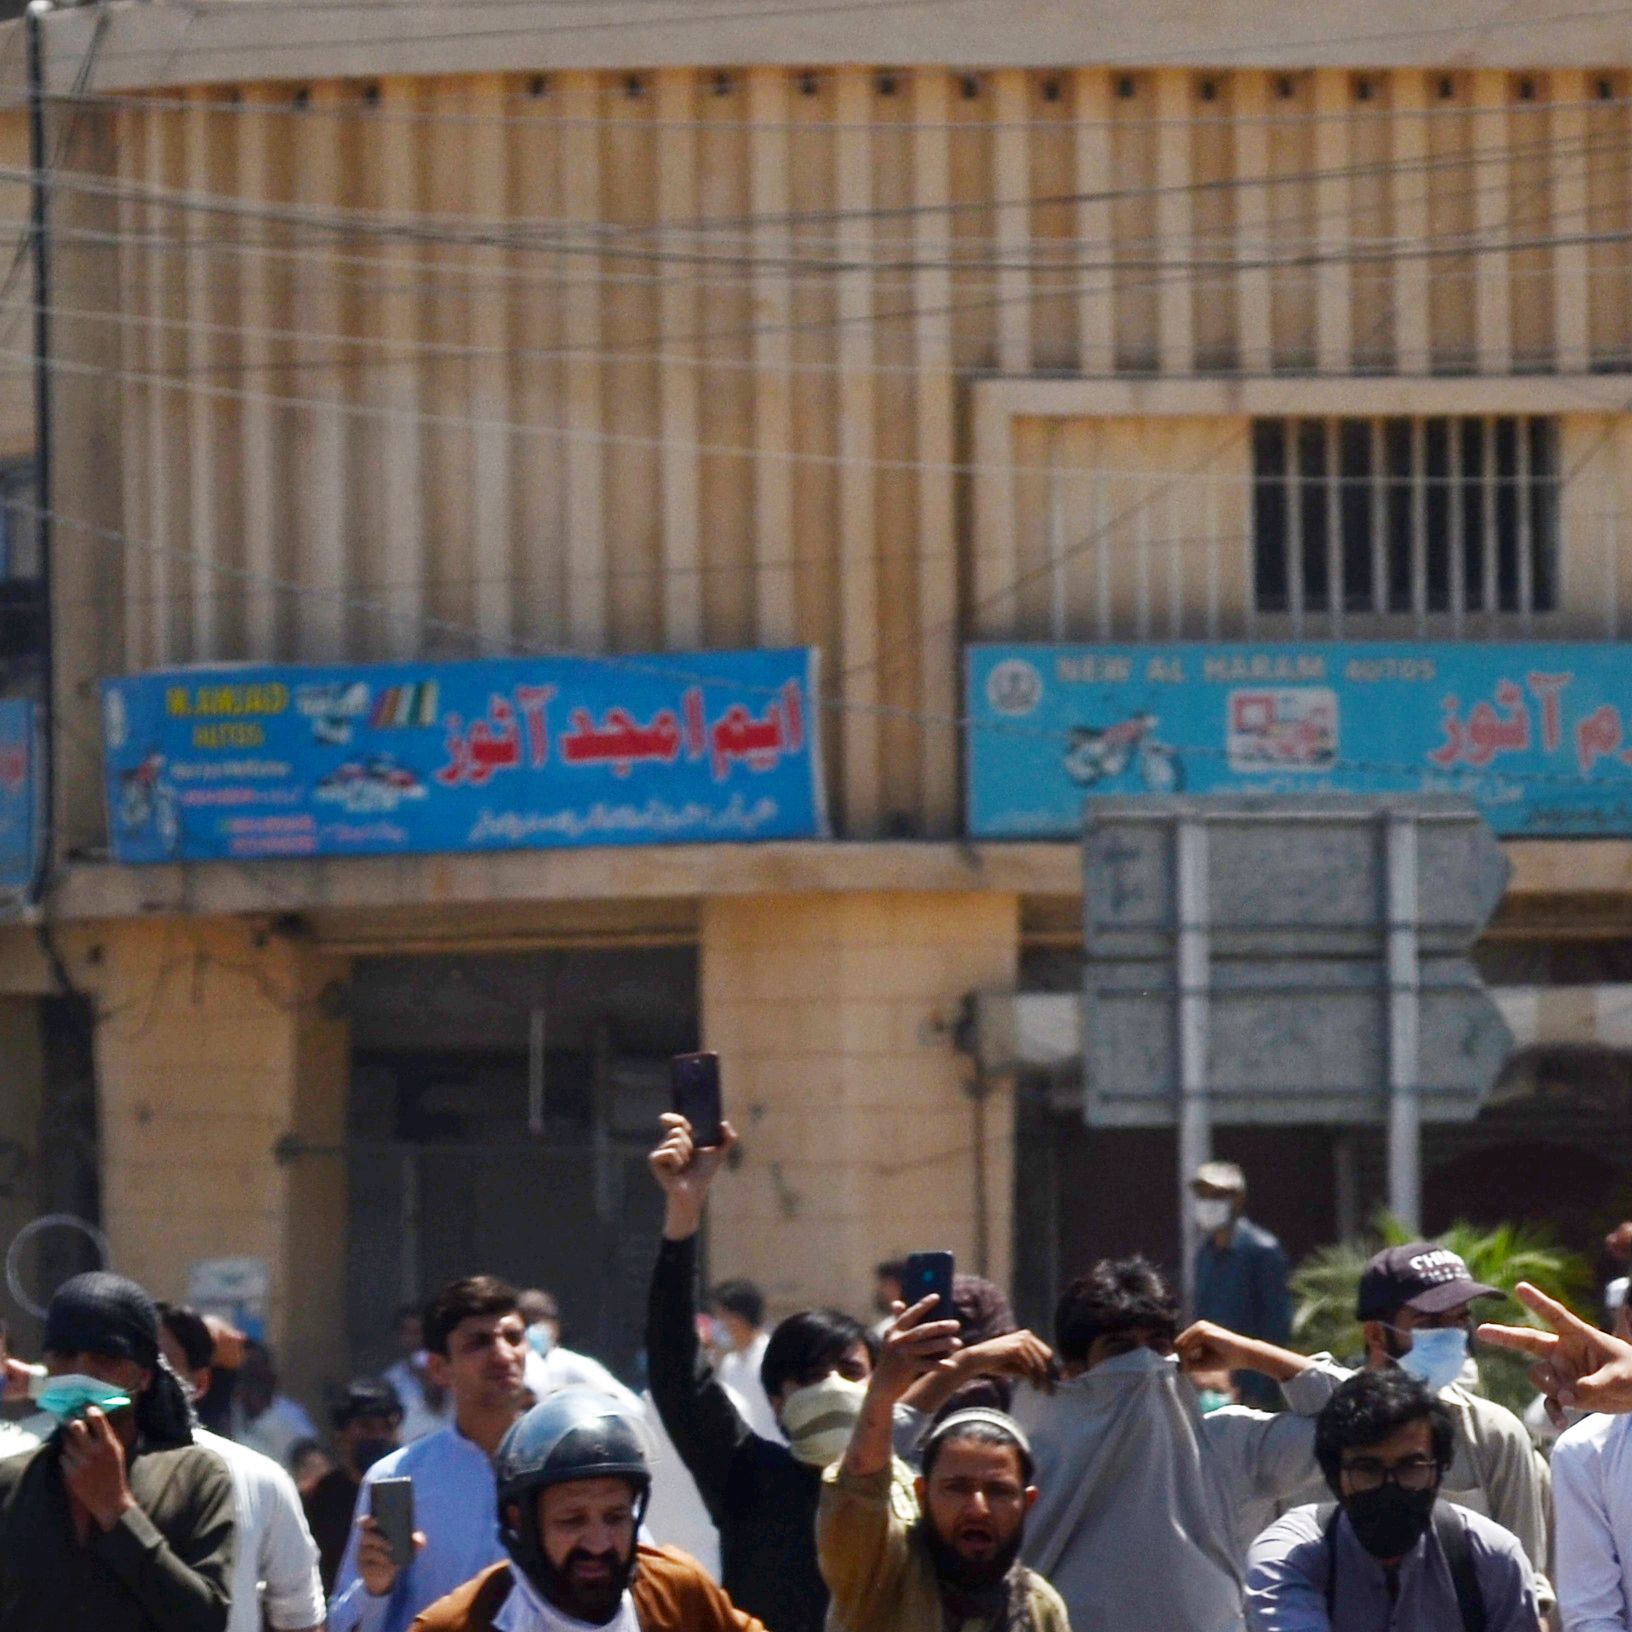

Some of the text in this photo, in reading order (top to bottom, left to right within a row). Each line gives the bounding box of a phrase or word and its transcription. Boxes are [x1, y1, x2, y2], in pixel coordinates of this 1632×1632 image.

[1056, 654, 1437, 683] NEW AL HARAM AUTOS
[559, 686, 705, 777] امجد
[710, 678, 804, 783] ایم
